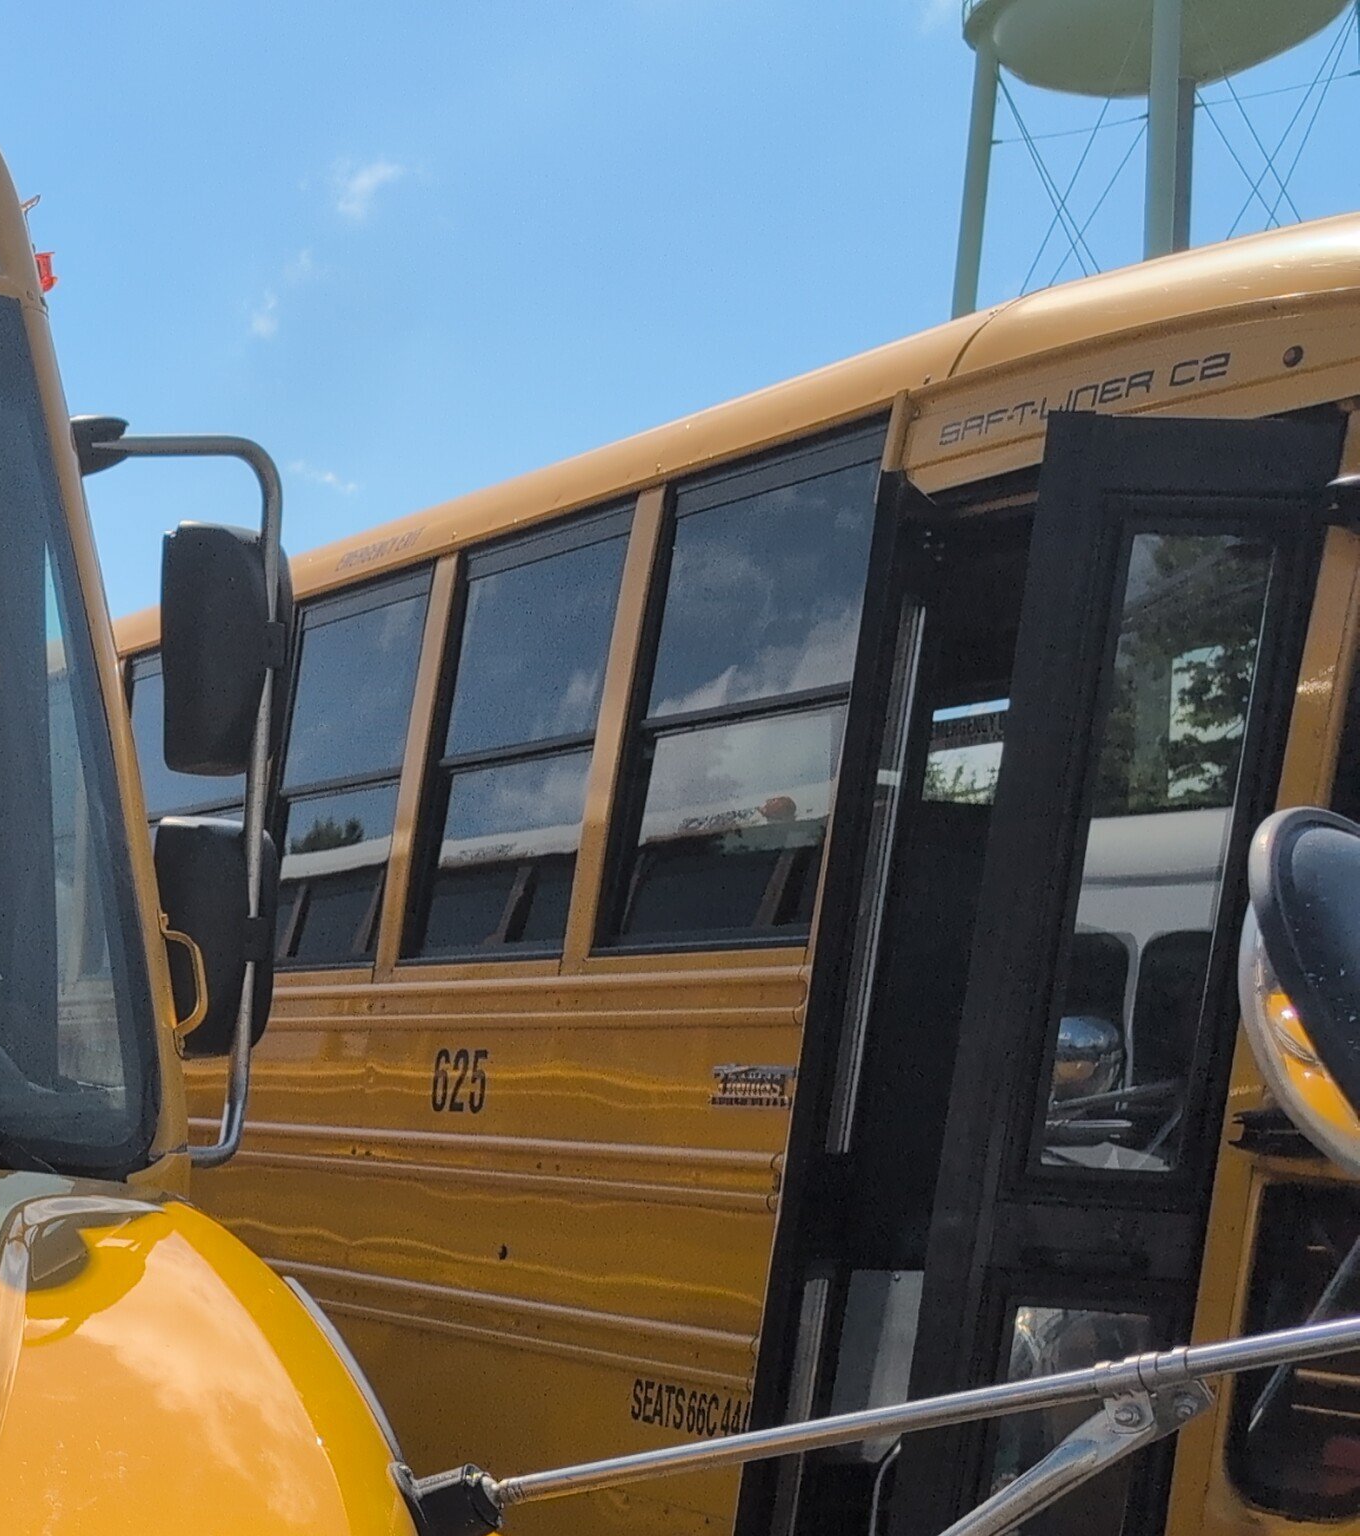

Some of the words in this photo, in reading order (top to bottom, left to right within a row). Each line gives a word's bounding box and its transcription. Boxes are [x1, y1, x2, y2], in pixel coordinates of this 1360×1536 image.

[1169, 353, 1230, 387] C2
[430, 1048, 489, 1114] 625
[631, 1378, 686, 1430] SEATS
[686, 1390, 719, 1437] 66C
